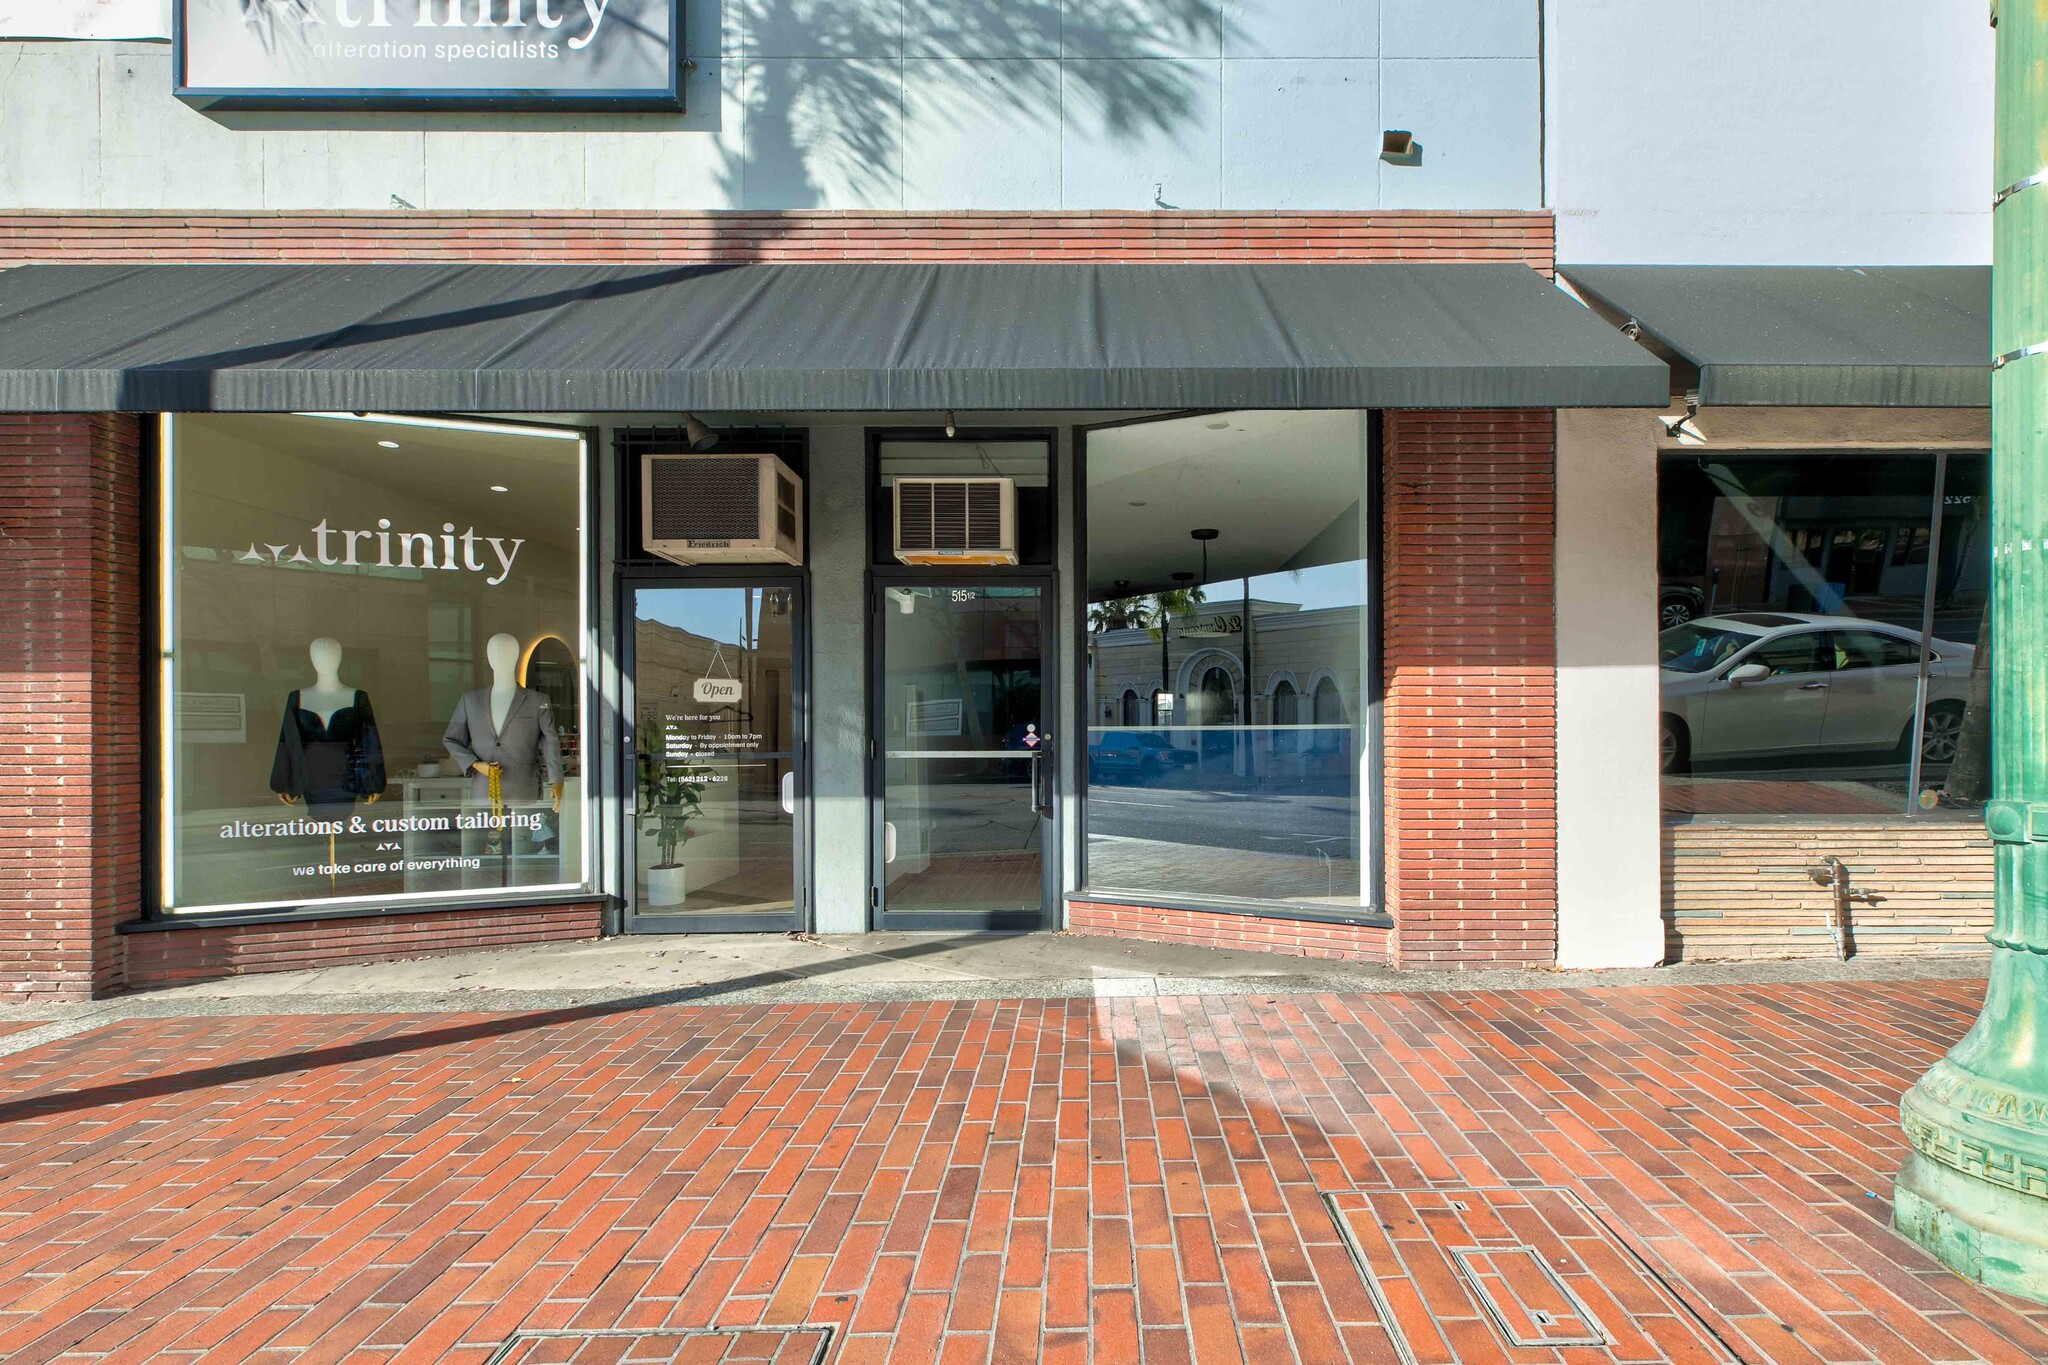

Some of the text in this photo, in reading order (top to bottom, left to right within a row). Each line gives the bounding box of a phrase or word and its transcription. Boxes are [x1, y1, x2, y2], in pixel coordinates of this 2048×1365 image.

[313, 40, 559, 62] alteration specialists
[310, 518, 526, 586] trinity
[951, 589, 967, 602] 515
[701, 681, 735, 698] Open
[709, 714, 721, 722] you
[697, 733, 716, 741] Friday
[748, 733, 763, 741] 7pm
[665, 742, 693, 750] Saturday
[708, 741, 746, 750] appointment
[746, 741, 760, 749] only
[665, 750, 689, 758] Sunday
[695, 750, 715, 758] closed
[678, 775, 695, 783] (562)
[219, 811, 543, 840] alterations & custom tailoring
[292, 857, 481, 876] we take care of everything
